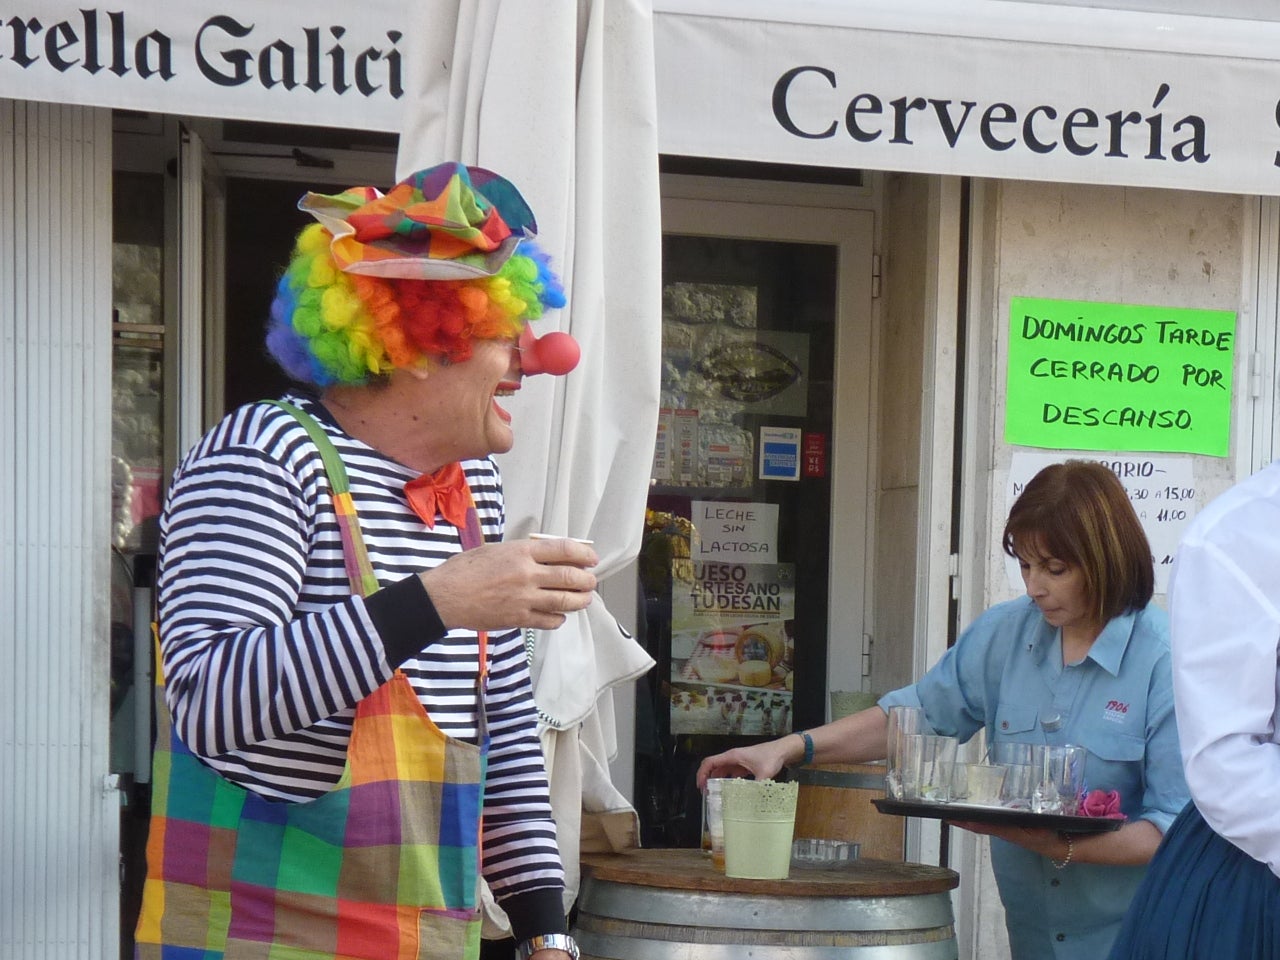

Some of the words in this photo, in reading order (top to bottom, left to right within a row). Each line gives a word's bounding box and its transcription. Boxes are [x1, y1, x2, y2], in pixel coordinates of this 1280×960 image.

[0, 8, 177, 82] rella
[771, 65, 1211, 165] Cervecería
[1155, 321, 1232, 351] TARDE
[1030, 358, 1160, 384] CERRADO
[1182, 364, 1226, 390] POR
[1043, 403, 1193, 430] DESCANSO.
[705, 507, 756, 521] LECHE
[722, 524, 746, 533] SIN
[700, 541, 769, 554] LACTOSA
[690, 581, 780, 597] ARTESANO
[1105, 700, 1130, 713] 1906
